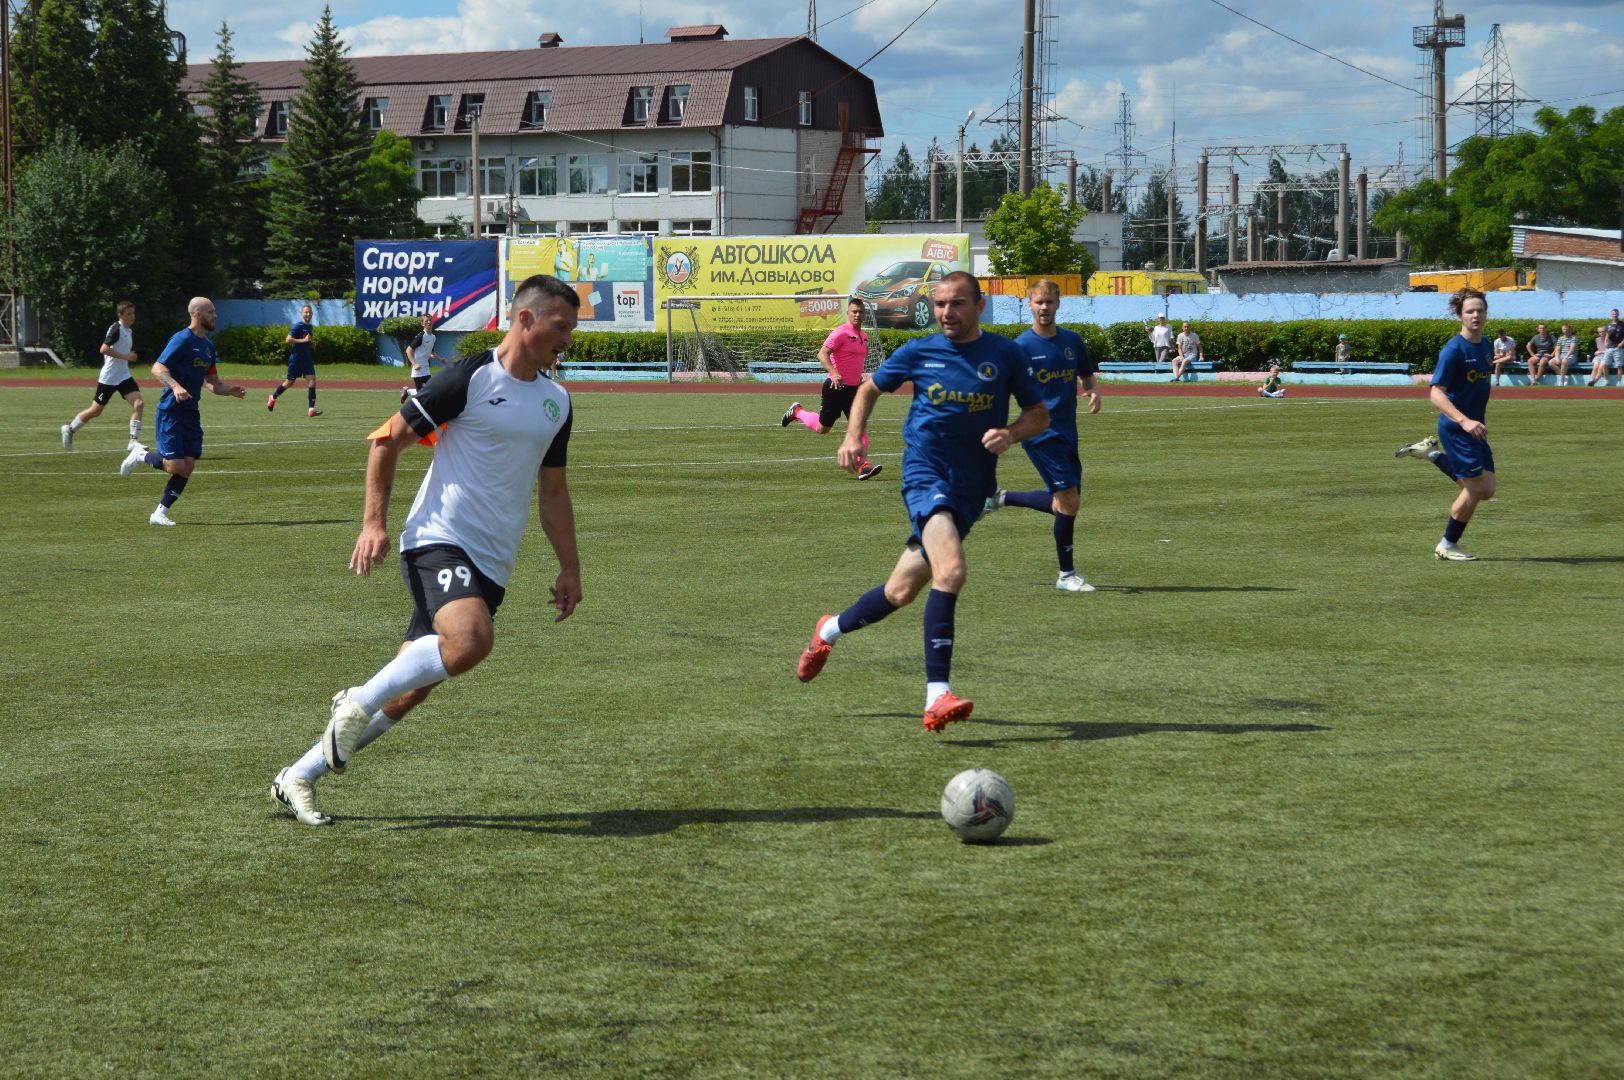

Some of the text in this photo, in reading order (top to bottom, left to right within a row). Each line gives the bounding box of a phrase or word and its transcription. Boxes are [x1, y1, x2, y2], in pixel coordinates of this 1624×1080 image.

[362, 247, 440, 274] Спорт
[709, 244, 836, 265] АВТОШКОЛА
[362, 276, 444, 299] норма
[362, 296, 452, 318] жизни!
[616, 294, 636, 308] top
[928, 383, 993, 405] GALAXY
[437, 565, 472, 593] 99
